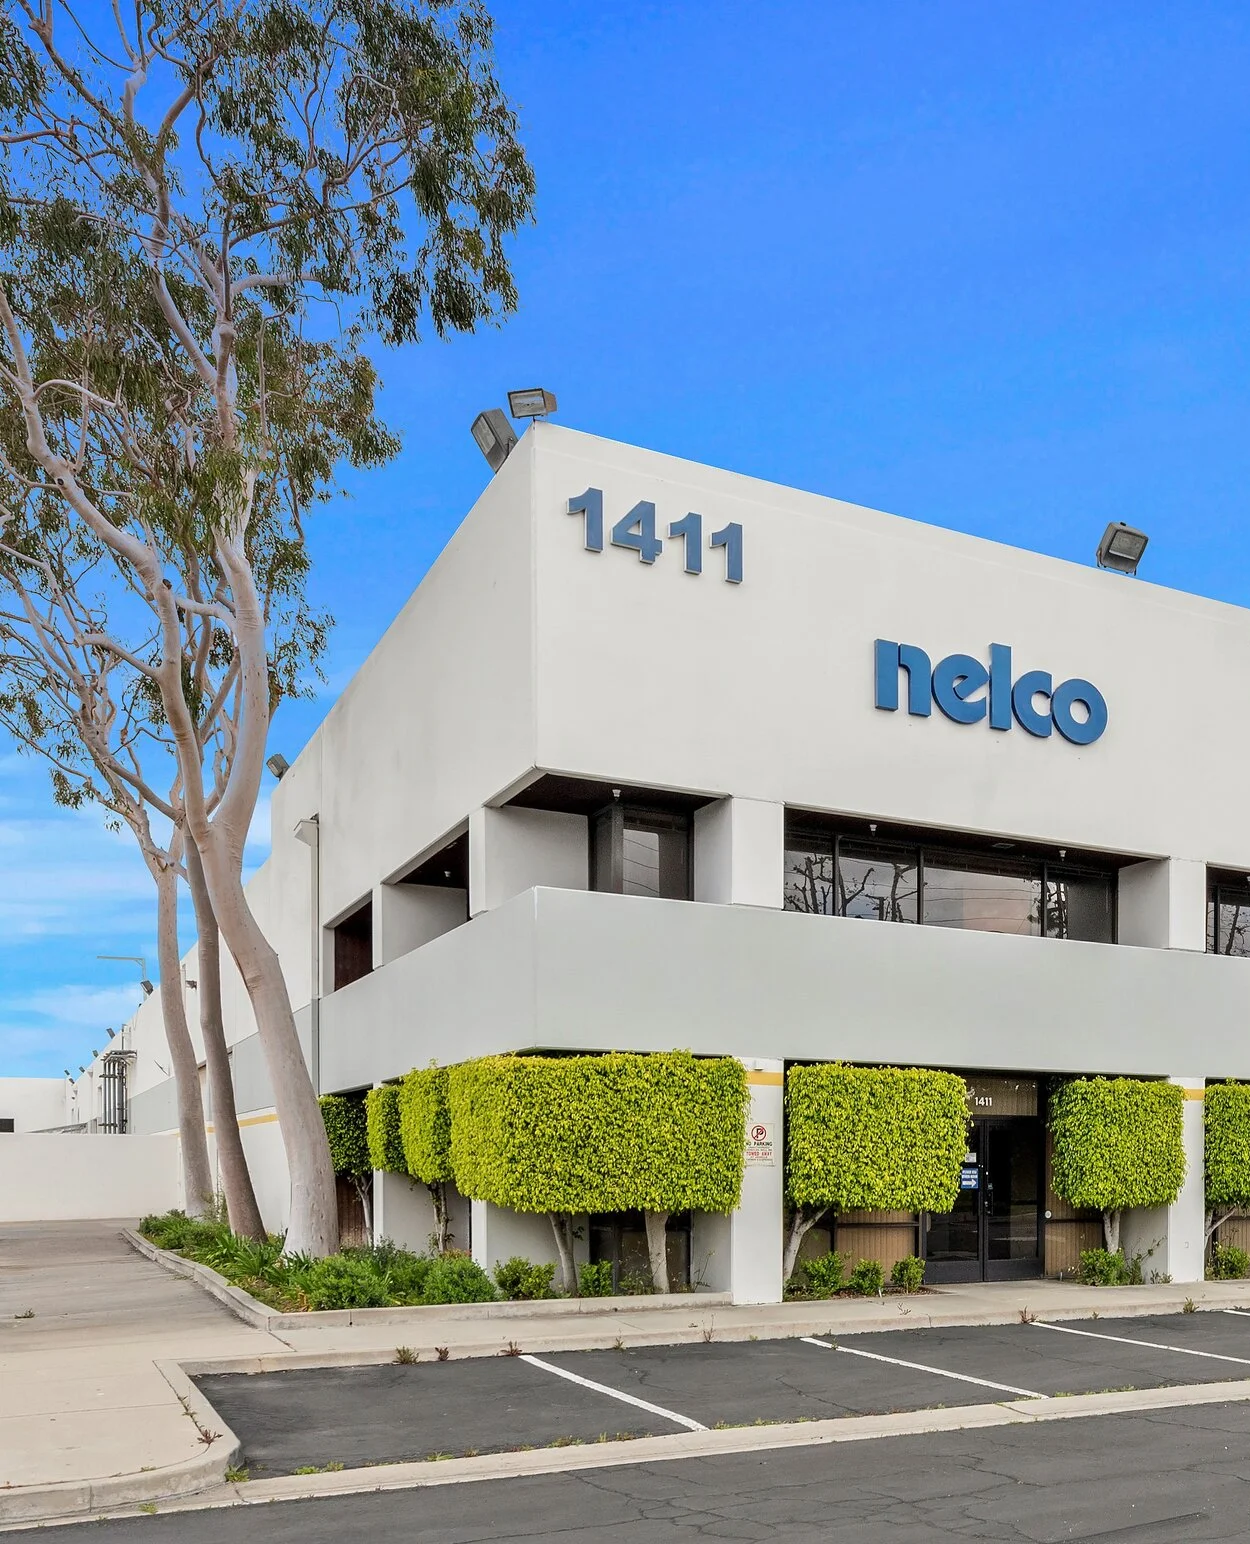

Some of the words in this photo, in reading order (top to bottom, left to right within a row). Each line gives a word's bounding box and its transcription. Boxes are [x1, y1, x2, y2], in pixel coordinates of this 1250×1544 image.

[567, 487, 743, 584] 1411
[874, 638, 1108, 746] nelco
[974, 1096, 993, 1107] 1411
